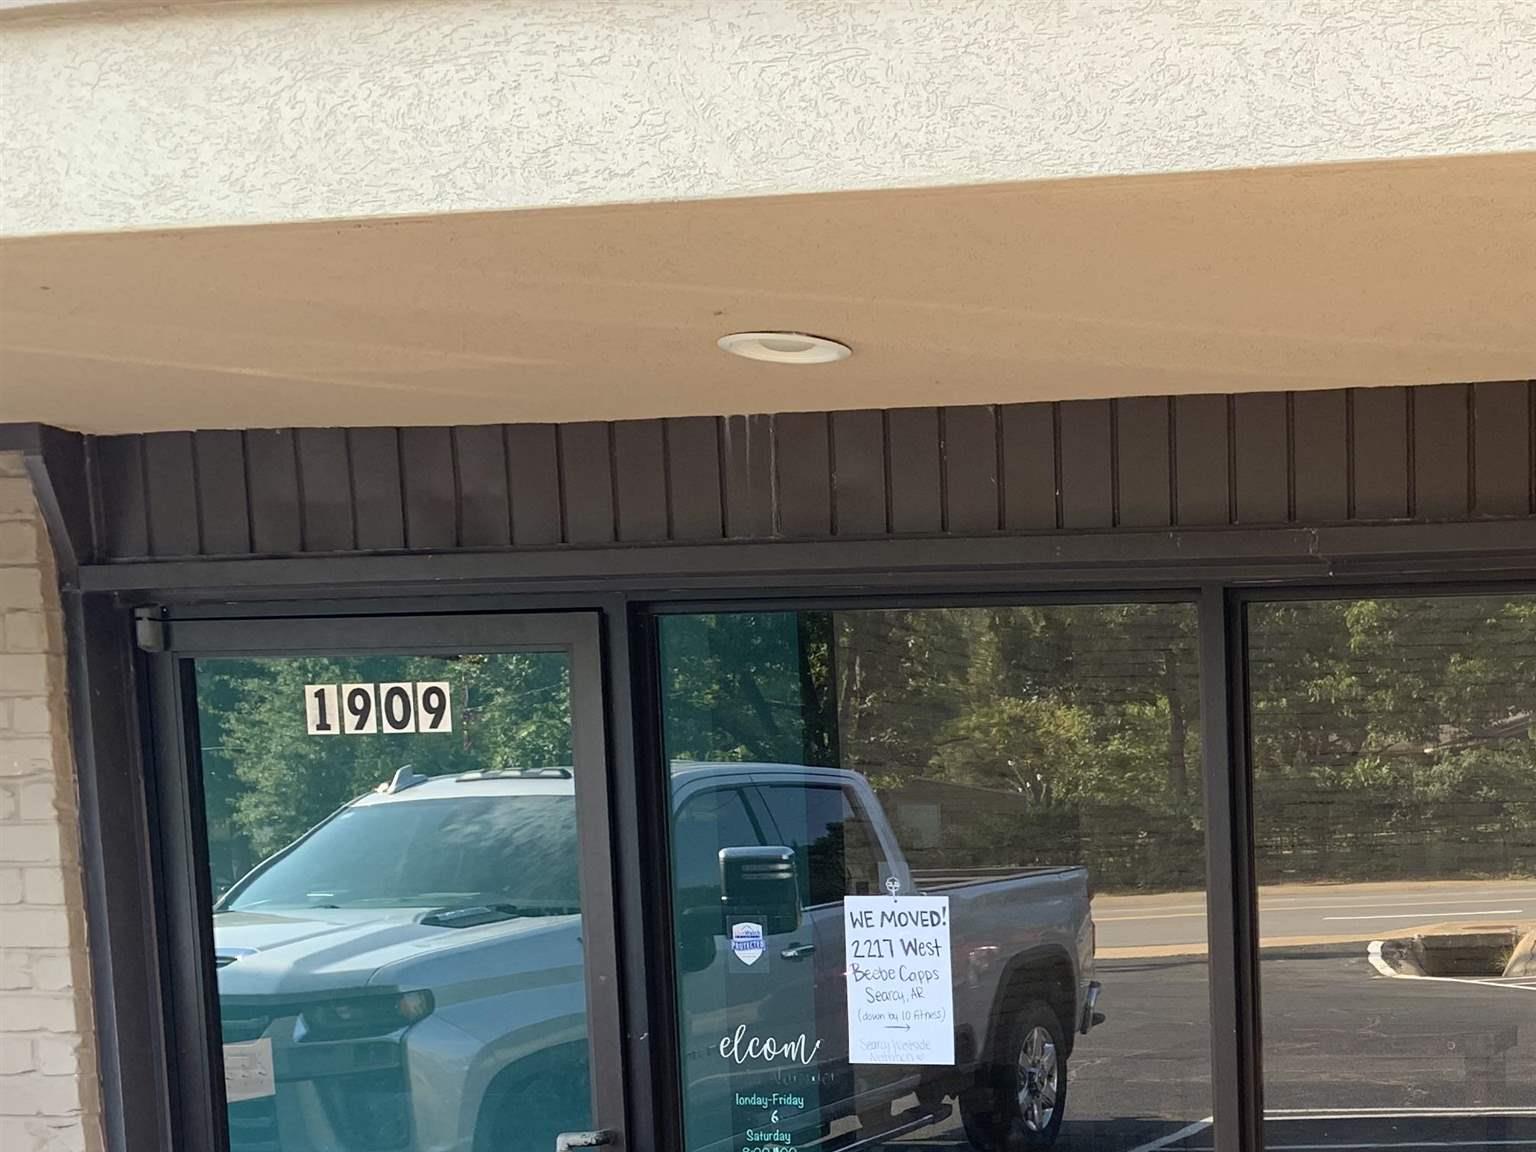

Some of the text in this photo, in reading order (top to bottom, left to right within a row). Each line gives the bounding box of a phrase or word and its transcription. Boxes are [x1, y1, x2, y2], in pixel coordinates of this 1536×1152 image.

[313, 685, 447, 731] 1909
[849, 906, 947, 929] WE MOVED!
[851, 938, 942, 958] 2217 West
[851, 962, 940, 985] Beebe Capps
[746, 1128, 792, 1145] Saturday
